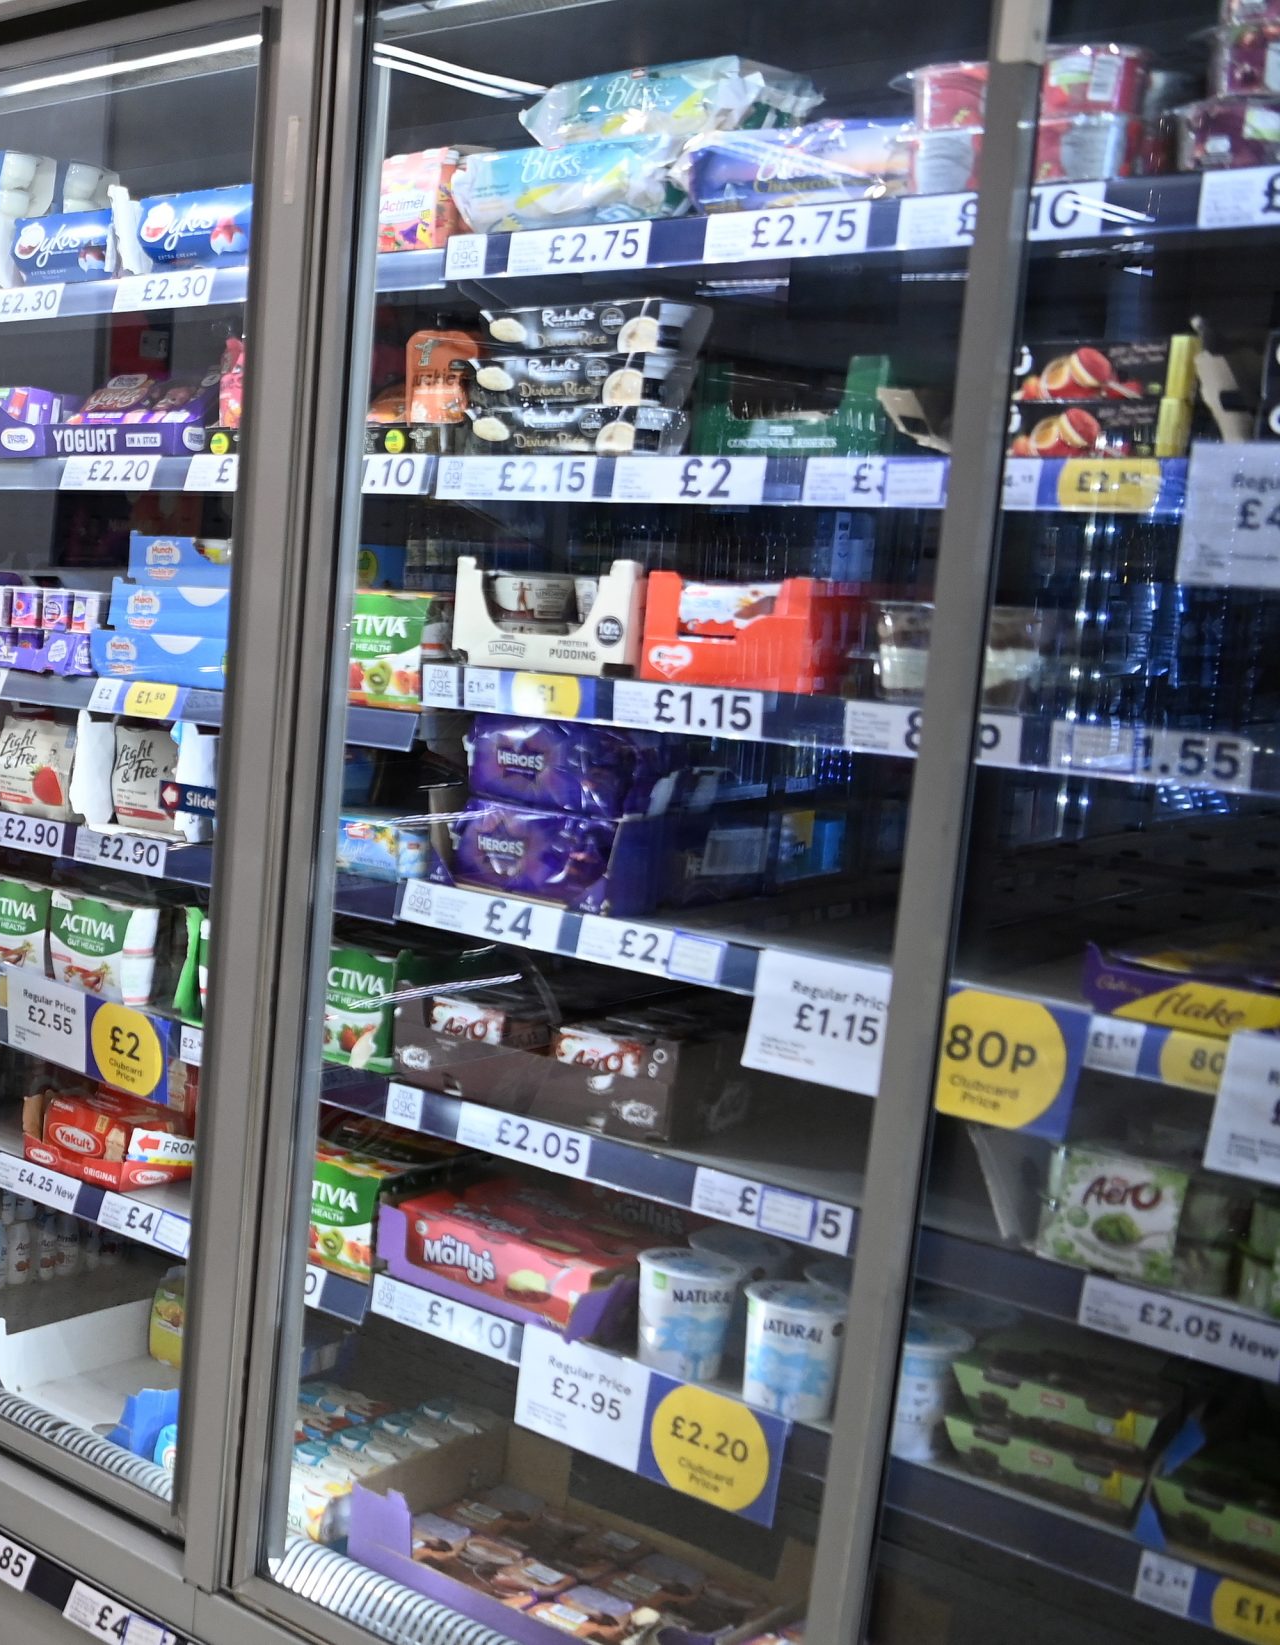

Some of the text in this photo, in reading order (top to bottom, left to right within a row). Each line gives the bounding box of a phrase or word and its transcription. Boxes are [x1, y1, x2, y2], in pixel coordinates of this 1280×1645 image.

[605, 75, 662, 110] Bliss
[522, 150, 581, 183] Bliss
[380, 194, 425, 214] Actimel
[140, 203, 214, 251] Oykos
[751, 209, 856, 248] £2.75
[16, 223, 80, 267] Oykos
[548, 229, 640, 265] £2.75
[0, 289, 58, 314] £2.30
[142, 275, 208, 301] £2.30
[542, 308, 595, 327] Rachel's
[580, 331, 608, 346] Rice
[519, 381, 593, 397] Divine Rice
[53, 429, 118, 453] YOGURT
[514, 433, 557, 448] Divine
[87, 460, 149, 481] £2.20
[498, 461, 586, 493] £2.15
[680, 458, 732, 497] £2
[600, 622, 619, 634] 10%
[549, 648, 596, 661] PUDDING
[557, 640, 588, 648] PROTEIN
[654, 688, 751, 731] £1.15
[1, 729, 36, 756] Light
[117, 740, 153, 769] Light
[4, 756, 12, 768] &
[497, 751, 545, 771] HEROES
[121, 769, 130, 782] &
[4, 818, 58, 848] £2.90
[477, 836, 524, 856] HEROES
[99, 837, 160, 867] £2.90
[3, 919, 26, 932] HEALTH
[61, 915, 115, 943] ACTIVIA
[484, 899, 532, 940] £4
[67, 937, 105, 953] GUT HEALTH
[23, 988, 76, 1015] Regular Price
[791, 980, 849, 1003] Regular
[29, 1005, 73, 1035] £2.55
[795, 1004, 878, 1046] £1.15
[109, 1026, 141, 1061] £2
[109, 1059, 143, 1077] Clubcard
[117, 1071, 136, 1083] Price
[949, 1075, 1020, 1099] Clubcard
[960, 1091, 1001, 1110] Price
[58, 1129, 92, 1150] Yakult
[495, 1120, 581, 1164] £2.05
[19, 1169, 75, 1200] £4.25 New
[84, 1167, 117, 1183] ORIGINAL
[1083, 1176, 1161, 1210] Aero
[423, 1237, 495, 1285] Molly's
[427, 1300, 506, 1349] £1.40
[1139, 1302, 1279, 1358] £2.05 New
[548, 1356, 632, 1396] Regular Price
[552, 1377, 621, 1420] £2.95
[671, 1415, 749, 1463] £2.20
[678, 1457, 735, 1486] Clubcard
[688, 1473, 719, 1494] Price
